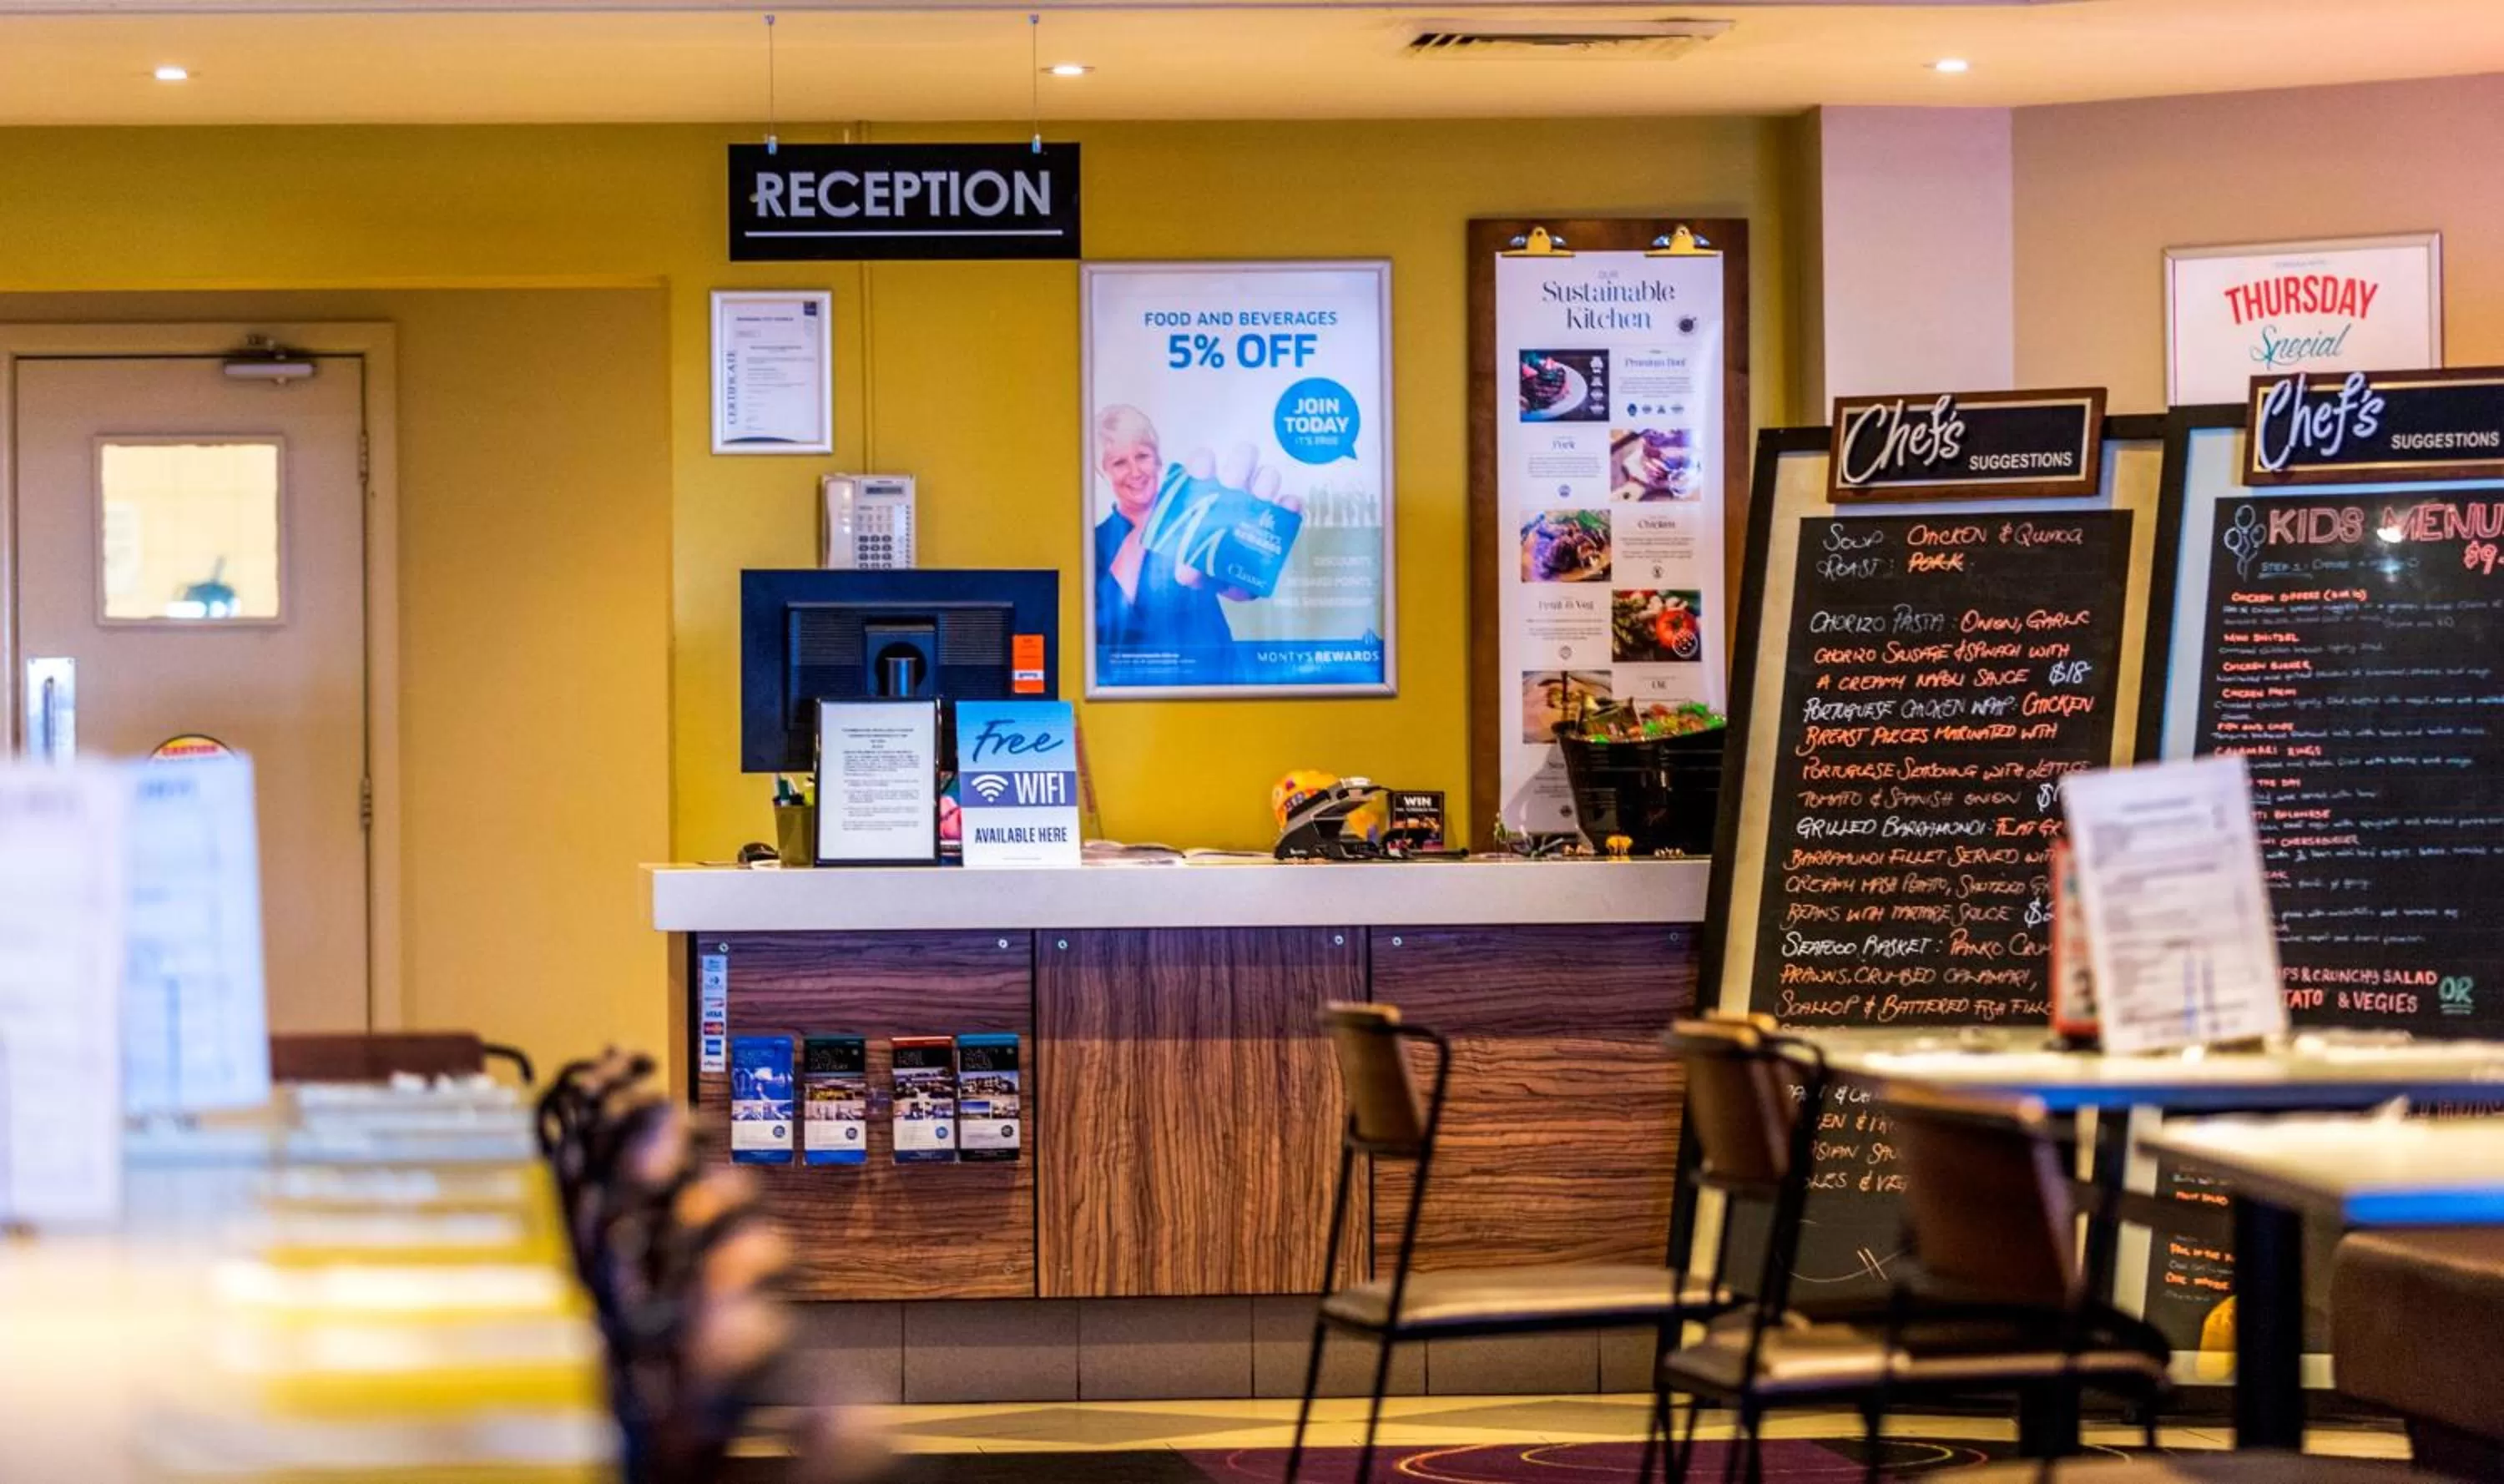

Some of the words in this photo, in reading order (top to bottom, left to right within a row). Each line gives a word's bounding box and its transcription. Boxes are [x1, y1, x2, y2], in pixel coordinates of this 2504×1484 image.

[756, 170, 1050, 218] RECEPTION
[1542, 280, 1676, 303] Sustainable
[2224, 275, 2379, 326] THURSDAY
[1144, 312, 1191, 326] FOOD
[1198, 311, 1233, 326] AND
[1239, 311, 1338, 326] BEVERAGES
[1566, 307, 1652, 331] Kitchen
[1169, 334, 1225, 369] 5%
[1237, 334, 1318, 368] OFF
[2247, 323, 2352, 371] Special
[1292, 398, 1340, 415] JOIN
[1283, 416, 1350, 434] TODAY
[2259, 372, 2385, 472] Chef's
[1842, 394, 1966, 484] Chef's
[2390, 432, 2501, 450] SUGGESTIONS
[1969, 452, 2073, 471] SUGGESTIONS
[2268, 507, 2365, 544] KIDS
[1315, 650, 1380, 662] REWARDS
[2048, 660, 2093, 686] $18
[972, 719, 1064, 762] Free
[1014, 772, 1067, 805] WIFI
[1403, 795, 1431, 807] WIN
[975, 826, 1036, 844] AVAILABLE
[1038, 825, 1068, 843] HERE
[1796, 816, 1877, 840] GRILLED
[2382, 969, 2438, 986] SALAD
[2281, 988, 2325, 1009] TATO
[2338, 993, 2350, 1009] &
[2353, 991, 2419, 1013] VEGIES
[2439, 976, 2474, 1004] OR
